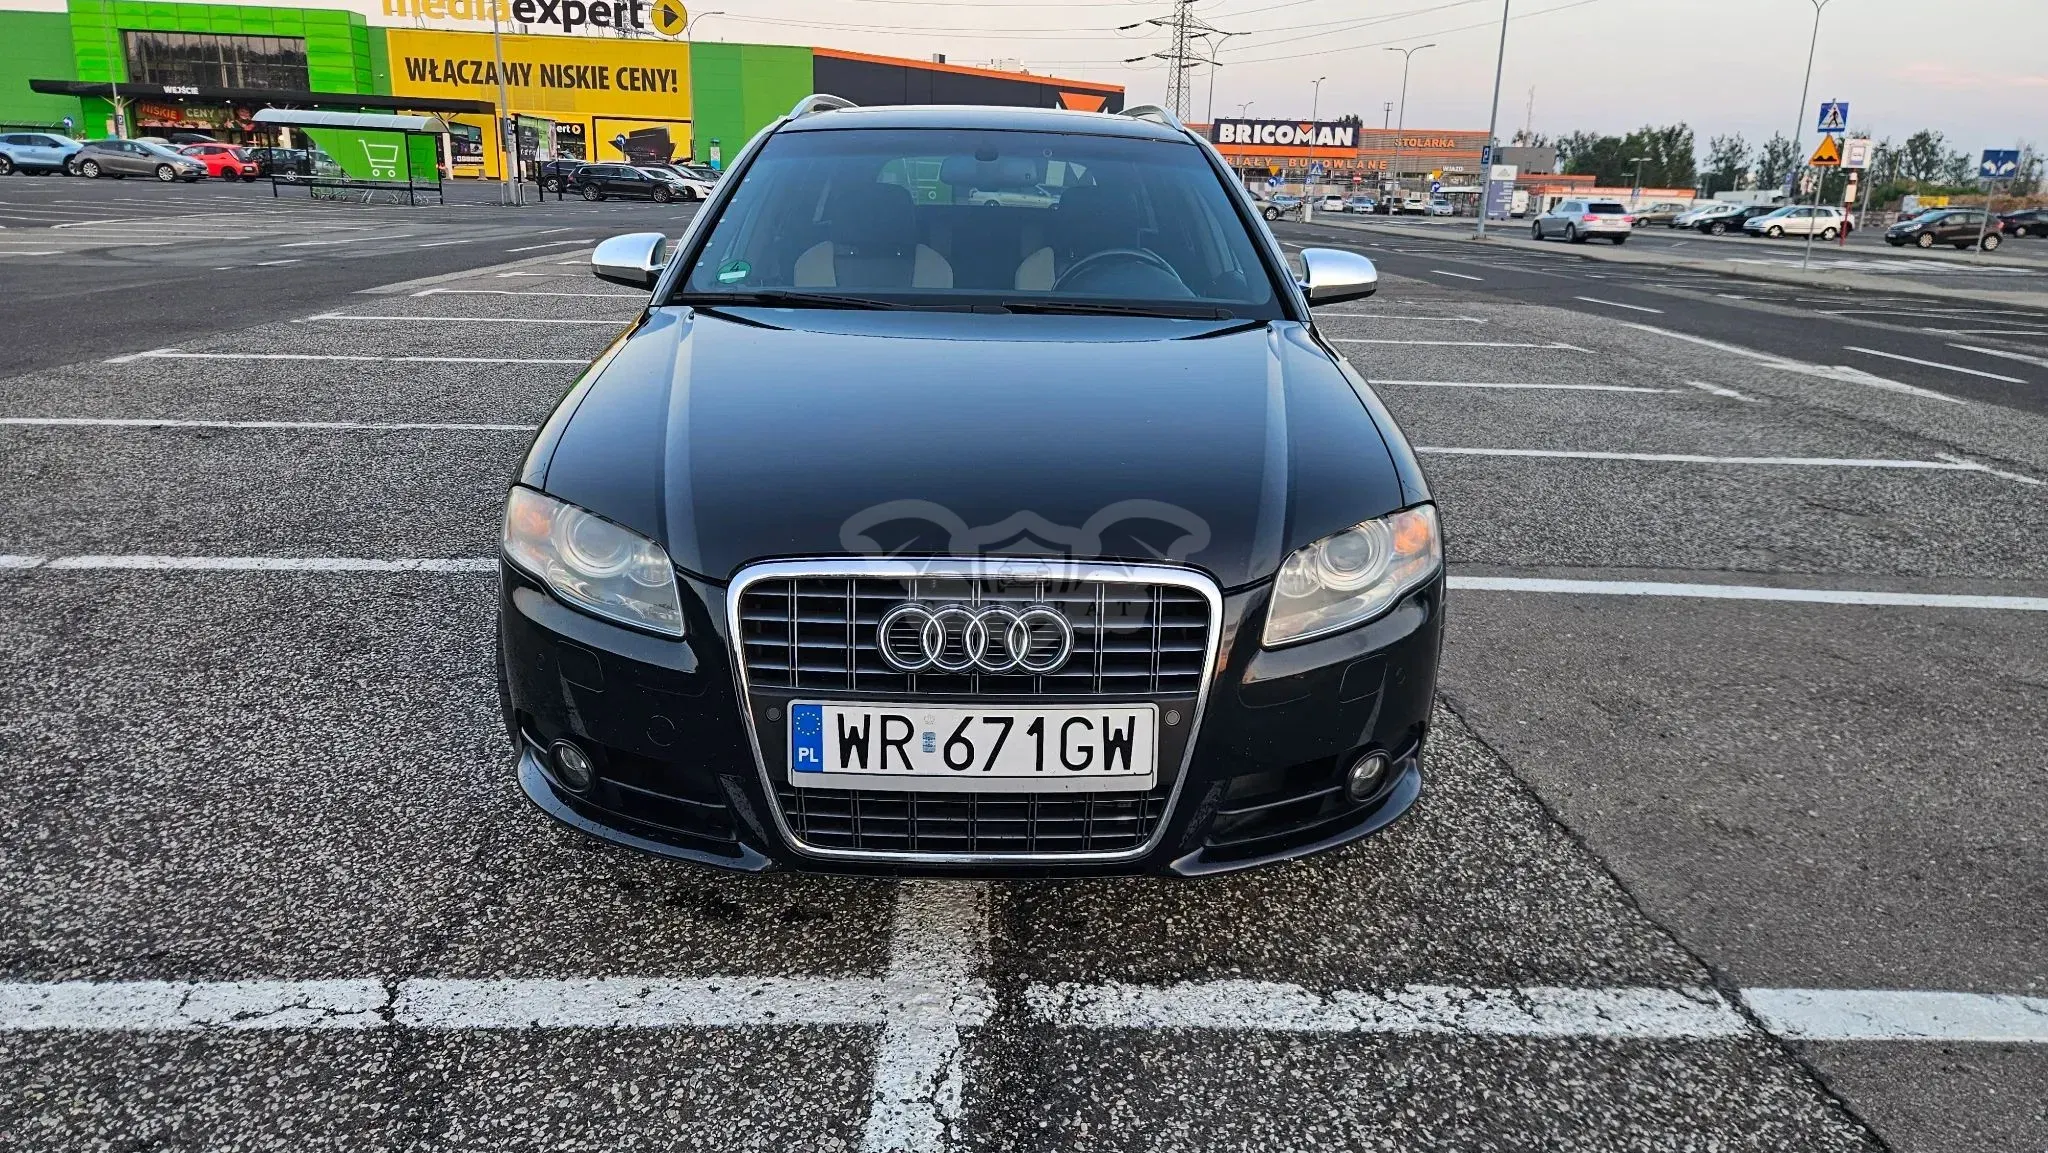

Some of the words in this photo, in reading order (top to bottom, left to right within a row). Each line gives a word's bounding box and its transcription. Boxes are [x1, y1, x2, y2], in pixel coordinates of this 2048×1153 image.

[405, 57, 533, 87] WŁĄCZAMY
[540, 63, 610, 90] NISKIE
[616, 67, 678, 93] CENY!
[185, 108, 214, 118] CENY
[1219, 123, 1353, 146] BRICOMAN
[1394, 138, 1455, 148] STOLARKA
[1225, 156, 1273, 168] RIAŁY
[837, 713, 915, 770] WR
[942, 715, 1136, 772] 671GW
[798, 747, 819, 763] PL
